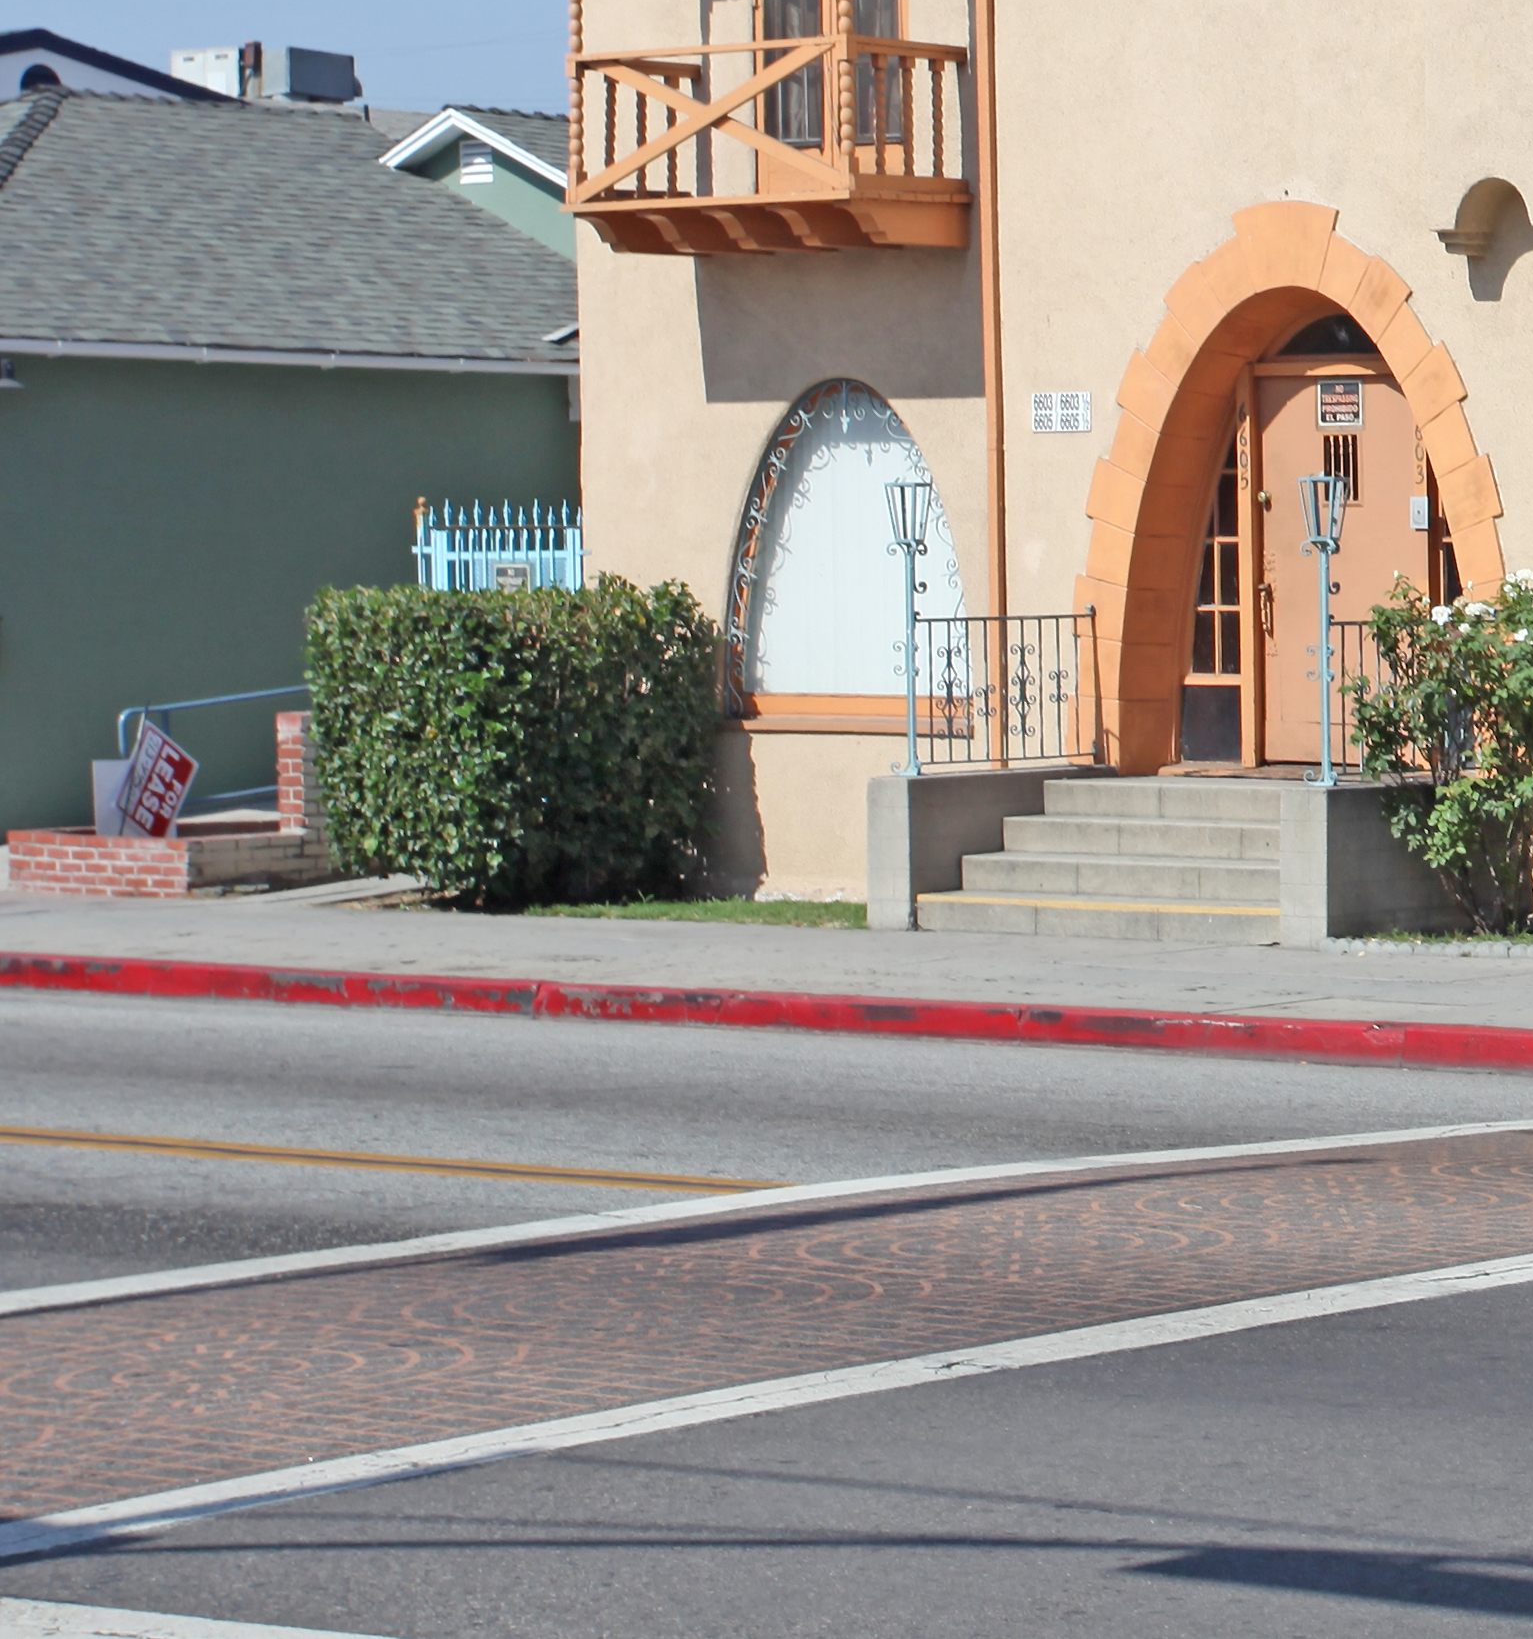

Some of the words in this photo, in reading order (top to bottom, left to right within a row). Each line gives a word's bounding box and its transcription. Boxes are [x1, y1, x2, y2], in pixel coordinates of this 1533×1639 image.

[1033, 393, 1053, 411] 6603
[1060, 393, 1080, 411] 6603
[1033, 412, 1053, 430] 6605
[1060, 412, 1080, 430] 6605
[133, 742, 181, 831] LEASE
[159, 779, 182, 819] FOR
